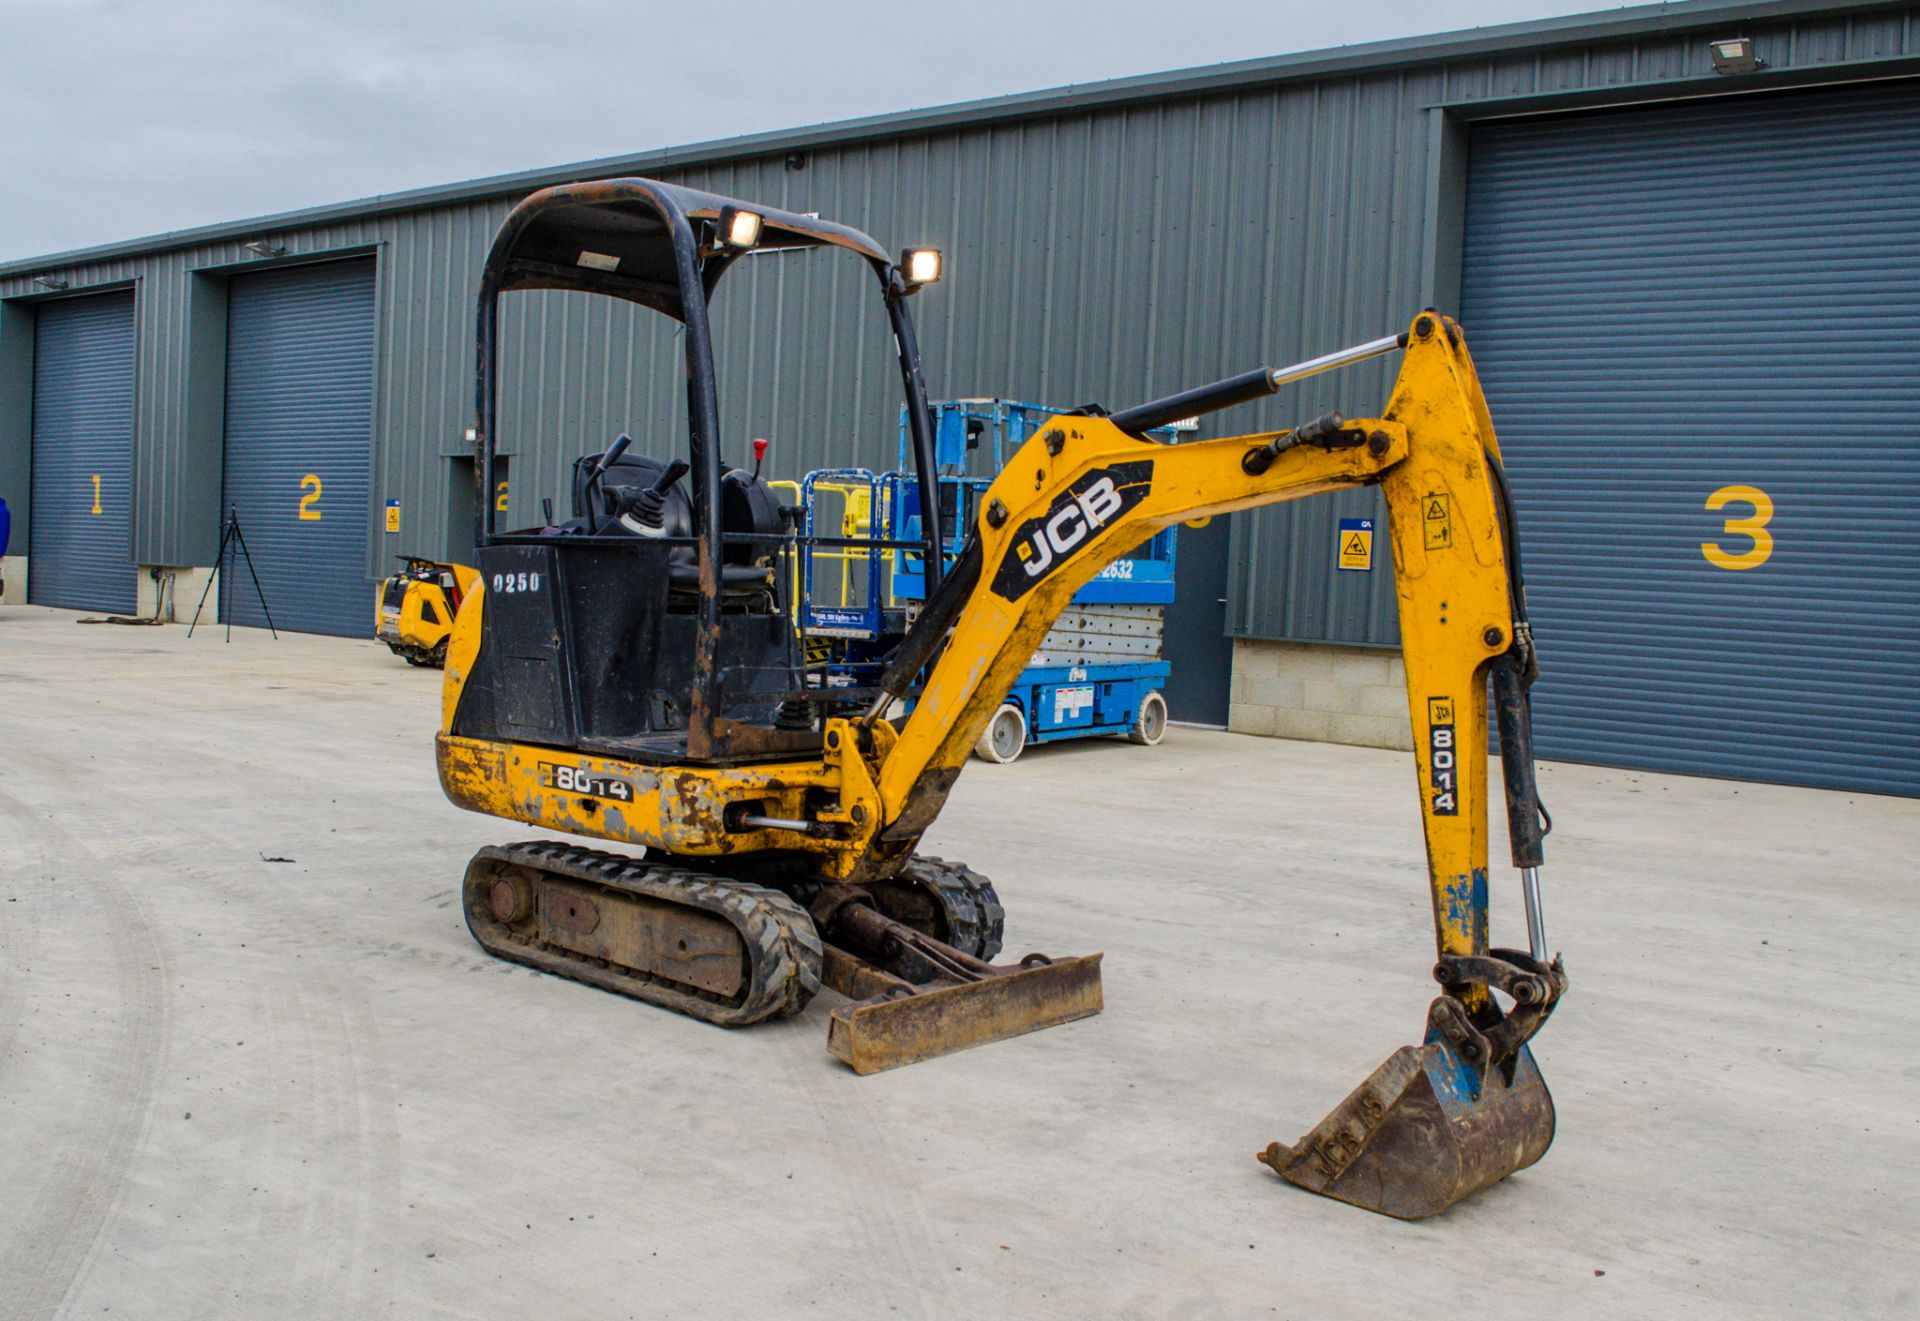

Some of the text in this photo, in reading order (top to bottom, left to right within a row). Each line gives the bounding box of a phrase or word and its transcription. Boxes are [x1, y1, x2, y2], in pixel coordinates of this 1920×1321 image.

[91, 474, 103, 514] 1
[298, 473, 322, 521] 2
[496, 481, 509, 511] 2
[1023, 476, 1122, 577] JCB
[1701, 485, 1774, 570] 3
[493, 572, 540, 594] 0250
[557, 766, 629, 800] 8014
[1432, 729, 1456, 811] 8014
[1312, 1128, 1361, 1176] JCB
